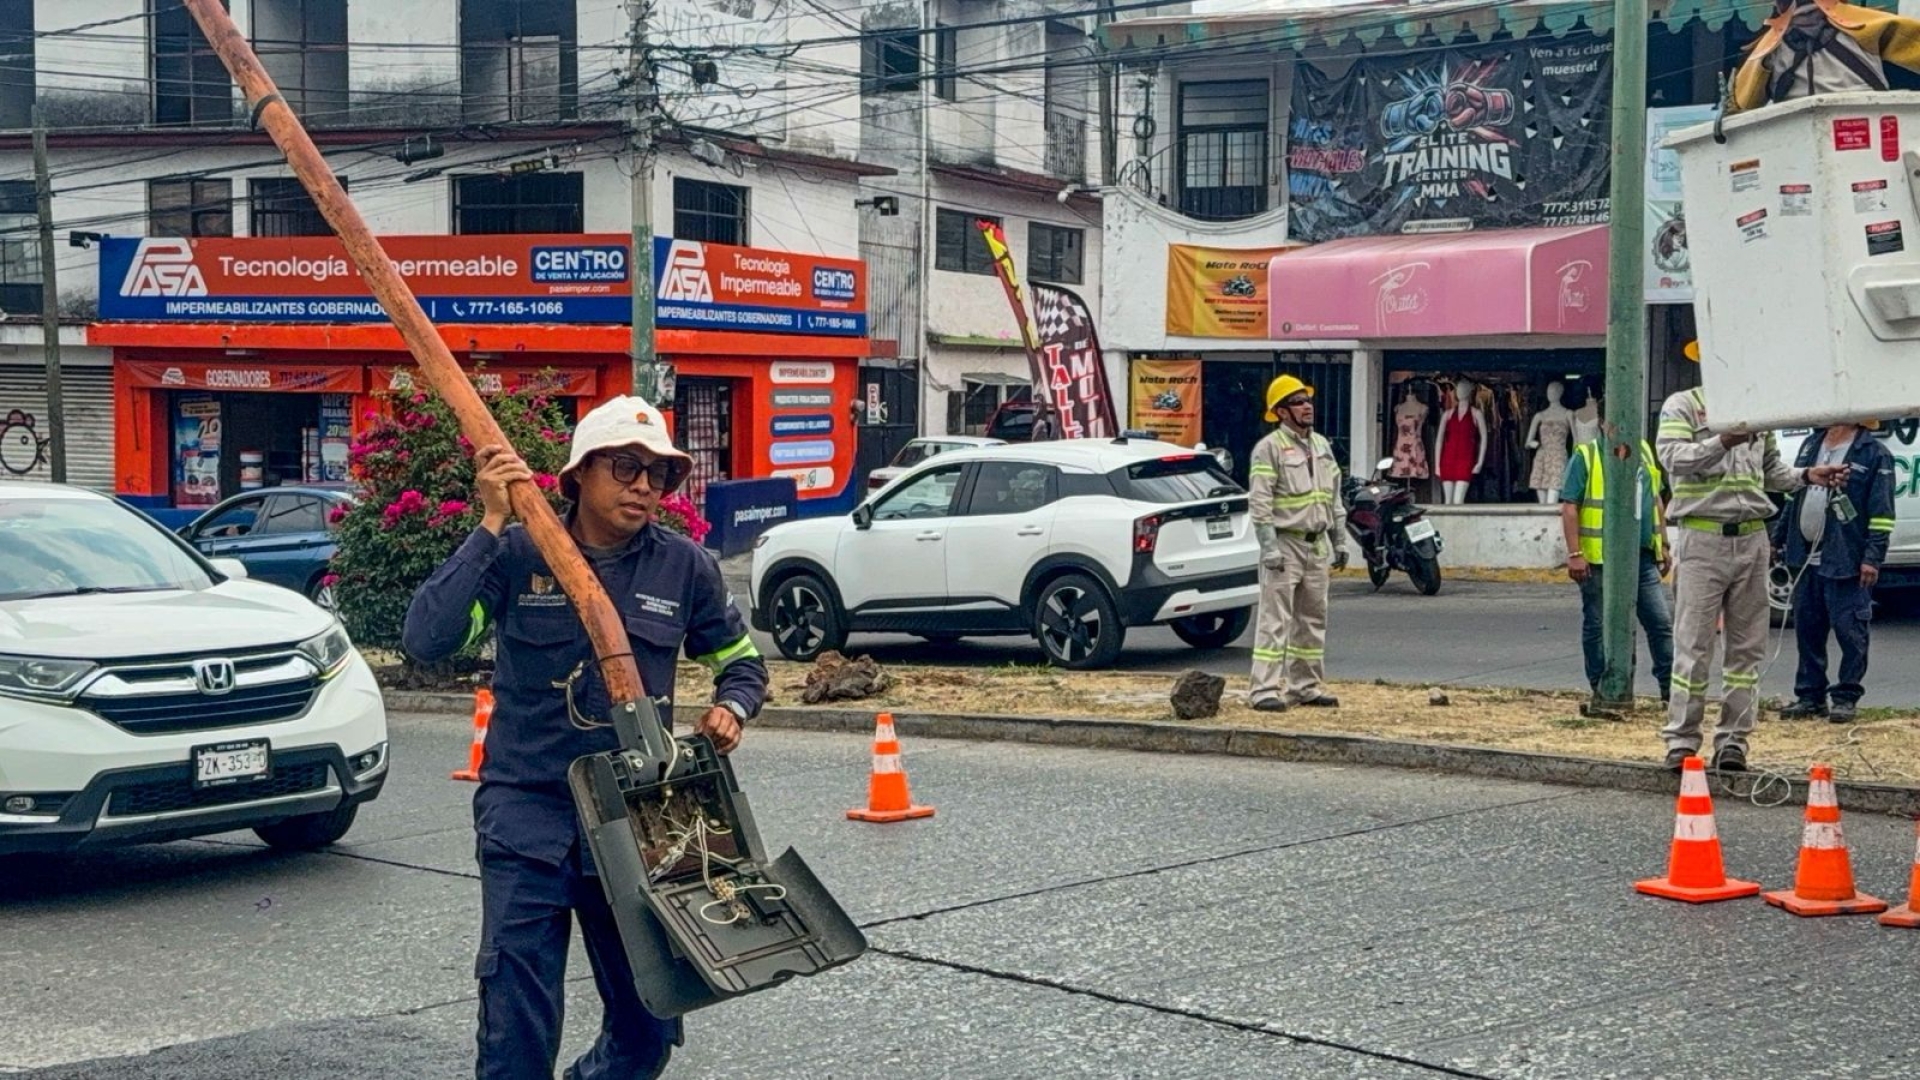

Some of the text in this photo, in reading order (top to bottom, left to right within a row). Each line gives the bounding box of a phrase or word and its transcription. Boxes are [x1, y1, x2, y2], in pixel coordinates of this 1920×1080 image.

[1529, 42, 1613, 58] Ven a tu clase
[1542, 60, 1598, 76] muestra!
[1419, 132, 1468, 145] ELITE
[1383, 143, 1513, 190] TRAINING
[1416, 170, 1468, 181] CENTER
[1420, 182, 1460, 198] MMA
[119, 238, 209, 297] PASA
[218, 255, 518, 281] Tecnología ermeable
[535, 250, 624, 270] CENTRO
[733, 253, 790, 277] Tecnología
[1205, 261, 1236, 269] Moto
[580, 270, 625, 279] APLICACIÓN
[658, 239, 713, 302] PASA
[814, 270, 855, 290] CENTRO
[720, 272, 802, 297] Impermeable
[166, 302, 388, 315] IMPERMEABILIZANTES GOBERNAD
[468, 302, 564, 315] 777-165-1066
[657, 306, 792, 326] IMPERMEABILIZANTES GOBERNADORES
[206, 370, 271, 388] GOBERNADORES
[1139, 376, 1165, 384] Moto
[1044, 343, 1083, 439] TALLE
[734, 505, 787, 527] pasaimper.com
